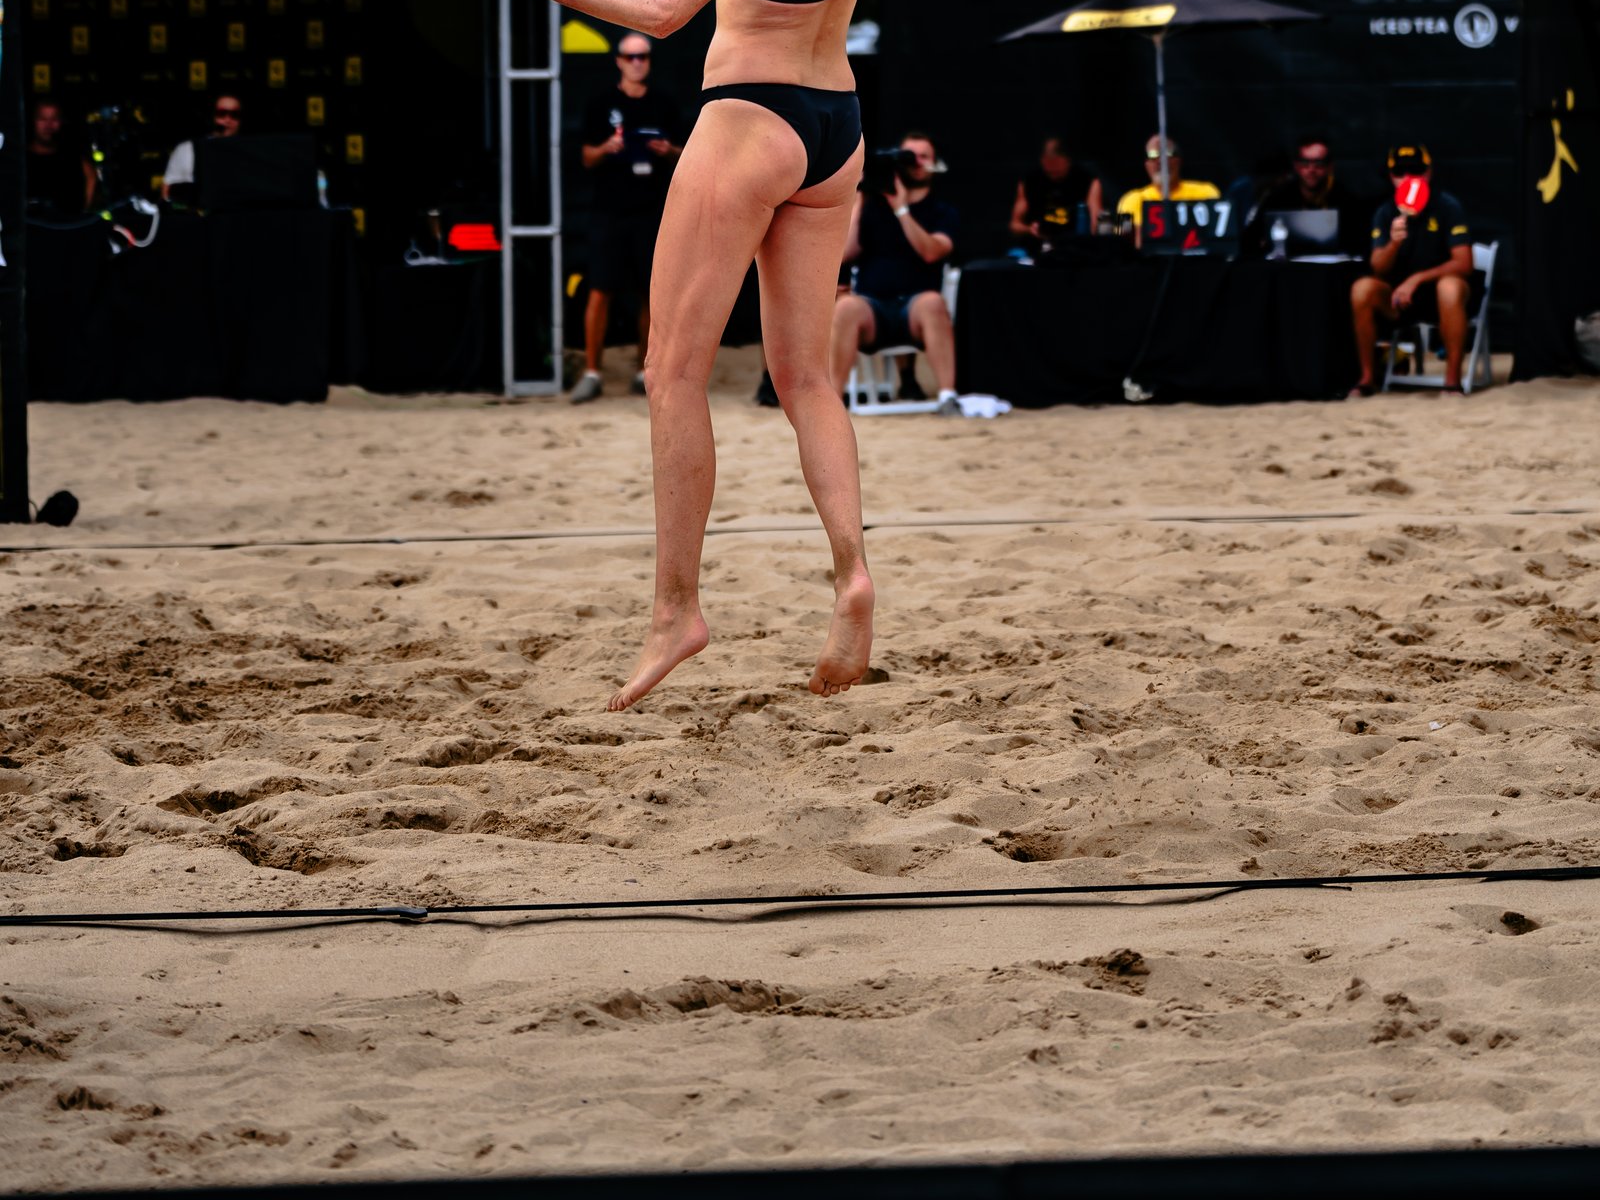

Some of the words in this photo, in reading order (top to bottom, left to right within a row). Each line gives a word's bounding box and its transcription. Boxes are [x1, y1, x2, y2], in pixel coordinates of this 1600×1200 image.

[1369, 17, 1412, 35] ICED
[1414, 16, 1449, 34] TEA
[1404, 177, 1421, 206] 1
[1147, 204, 1166, 239] 5
[1213, 200, 1232, 238] 7
